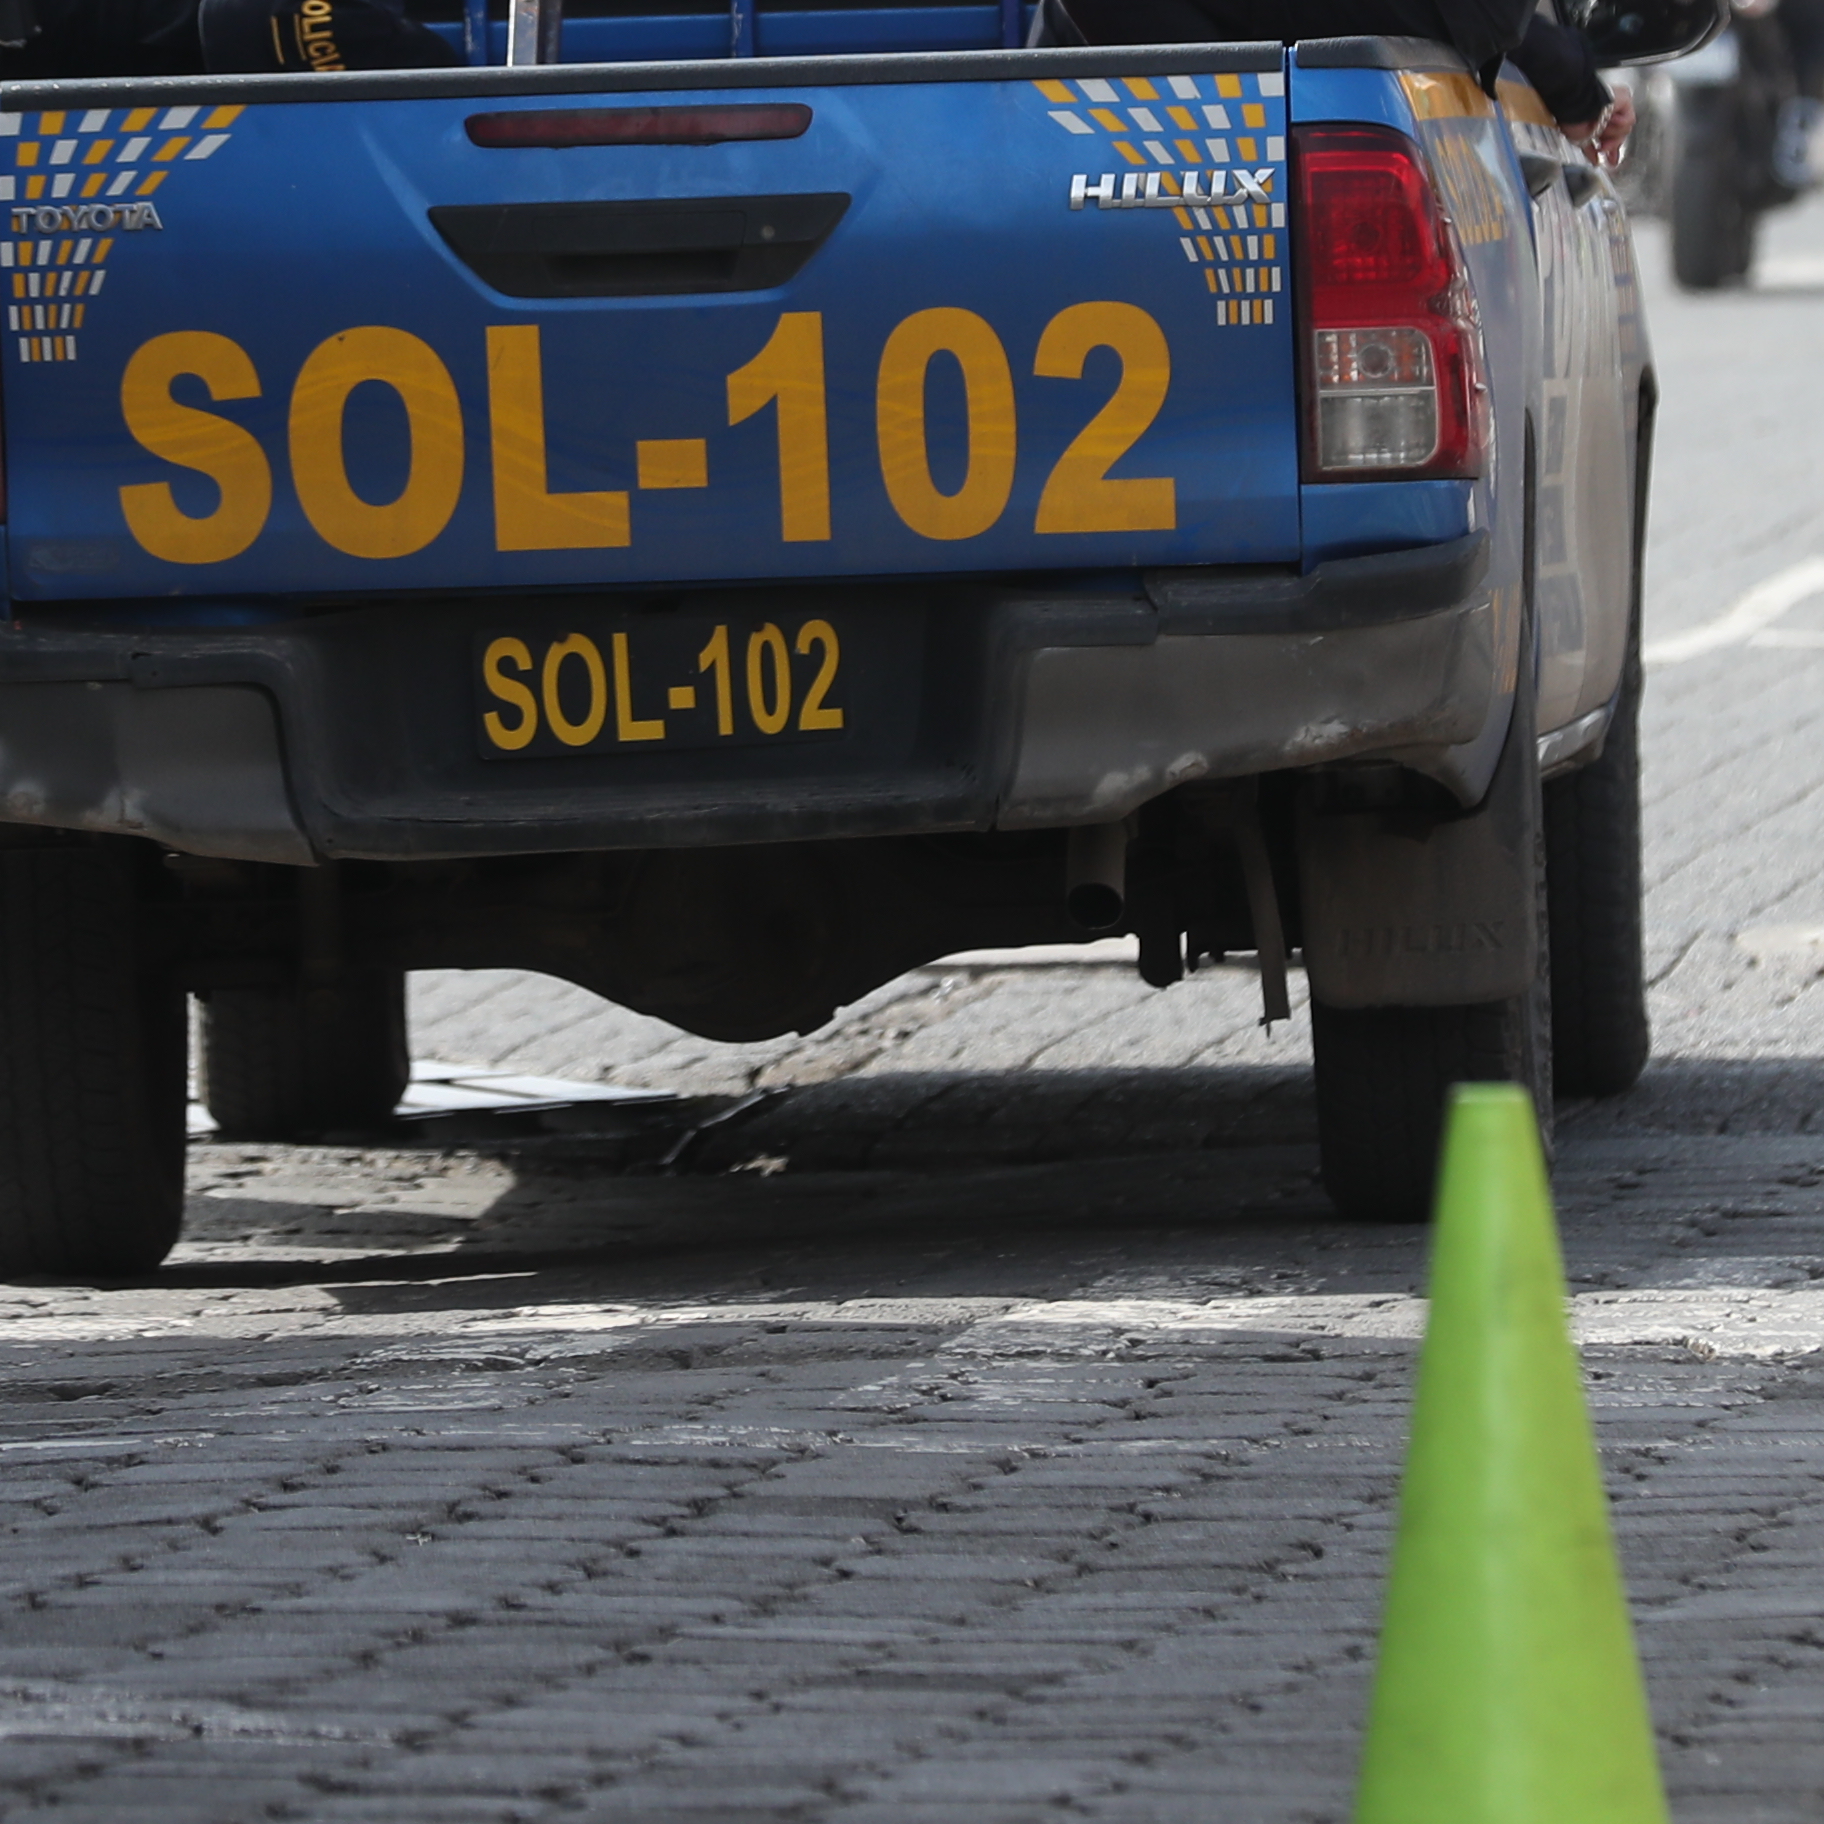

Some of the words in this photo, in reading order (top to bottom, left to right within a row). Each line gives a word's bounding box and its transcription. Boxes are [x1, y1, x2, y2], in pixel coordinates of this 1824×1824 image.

[11, 201, 163, 234] TOYOTA
[1070, 168, 1275, 209] HILUX
[118, 300, 1175, 564] SOL-102
[483, 619, 844, 750] SOL-102
